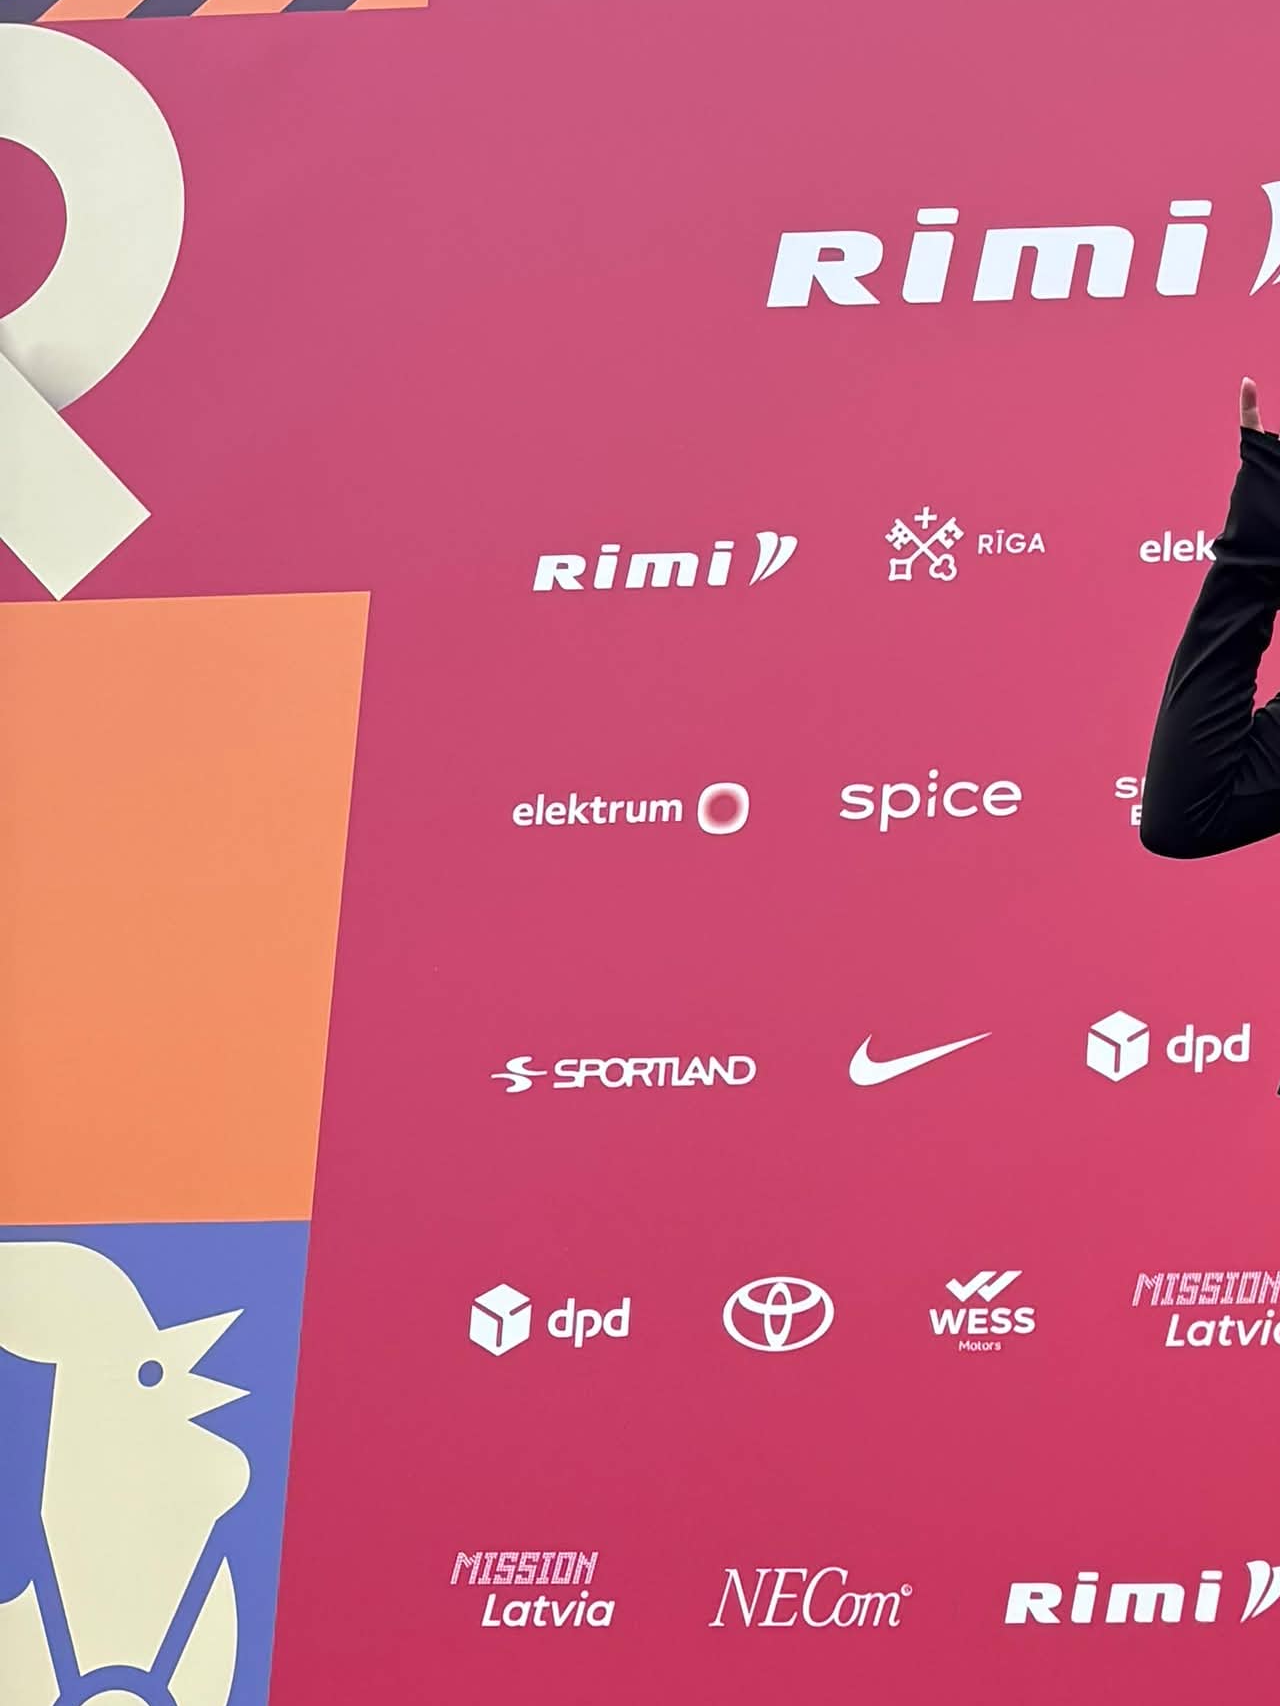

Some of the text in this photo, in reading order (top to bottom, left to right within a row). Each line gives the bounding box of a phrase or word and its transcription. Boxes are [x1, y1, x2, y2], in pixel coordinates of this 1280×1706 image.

[767, 200, 1212, 307] Rimi
[978, 530, 1044, 554] RĪGA
[1139, 530, 1217, 563] elek
[533, 541, 734, 590] Rimi
[513, 793, 682, 825] elektrum
[840, 770, 1021, 831] spice
[1167, 1024, 1250, 1072] dpd
[554, 1056, 756, 1088] SPORTLAND
[548, 1298, 630, 1347] dpd
[930, 1308, 1035, 1334] WESS
[958, 1340, 1002, 1352] Motors
[451, 1552, 598, 1584] MISSION
[482, 1591, 614, 1626] Latvia
[1005, 1571, 1222, 1623] Rimi
